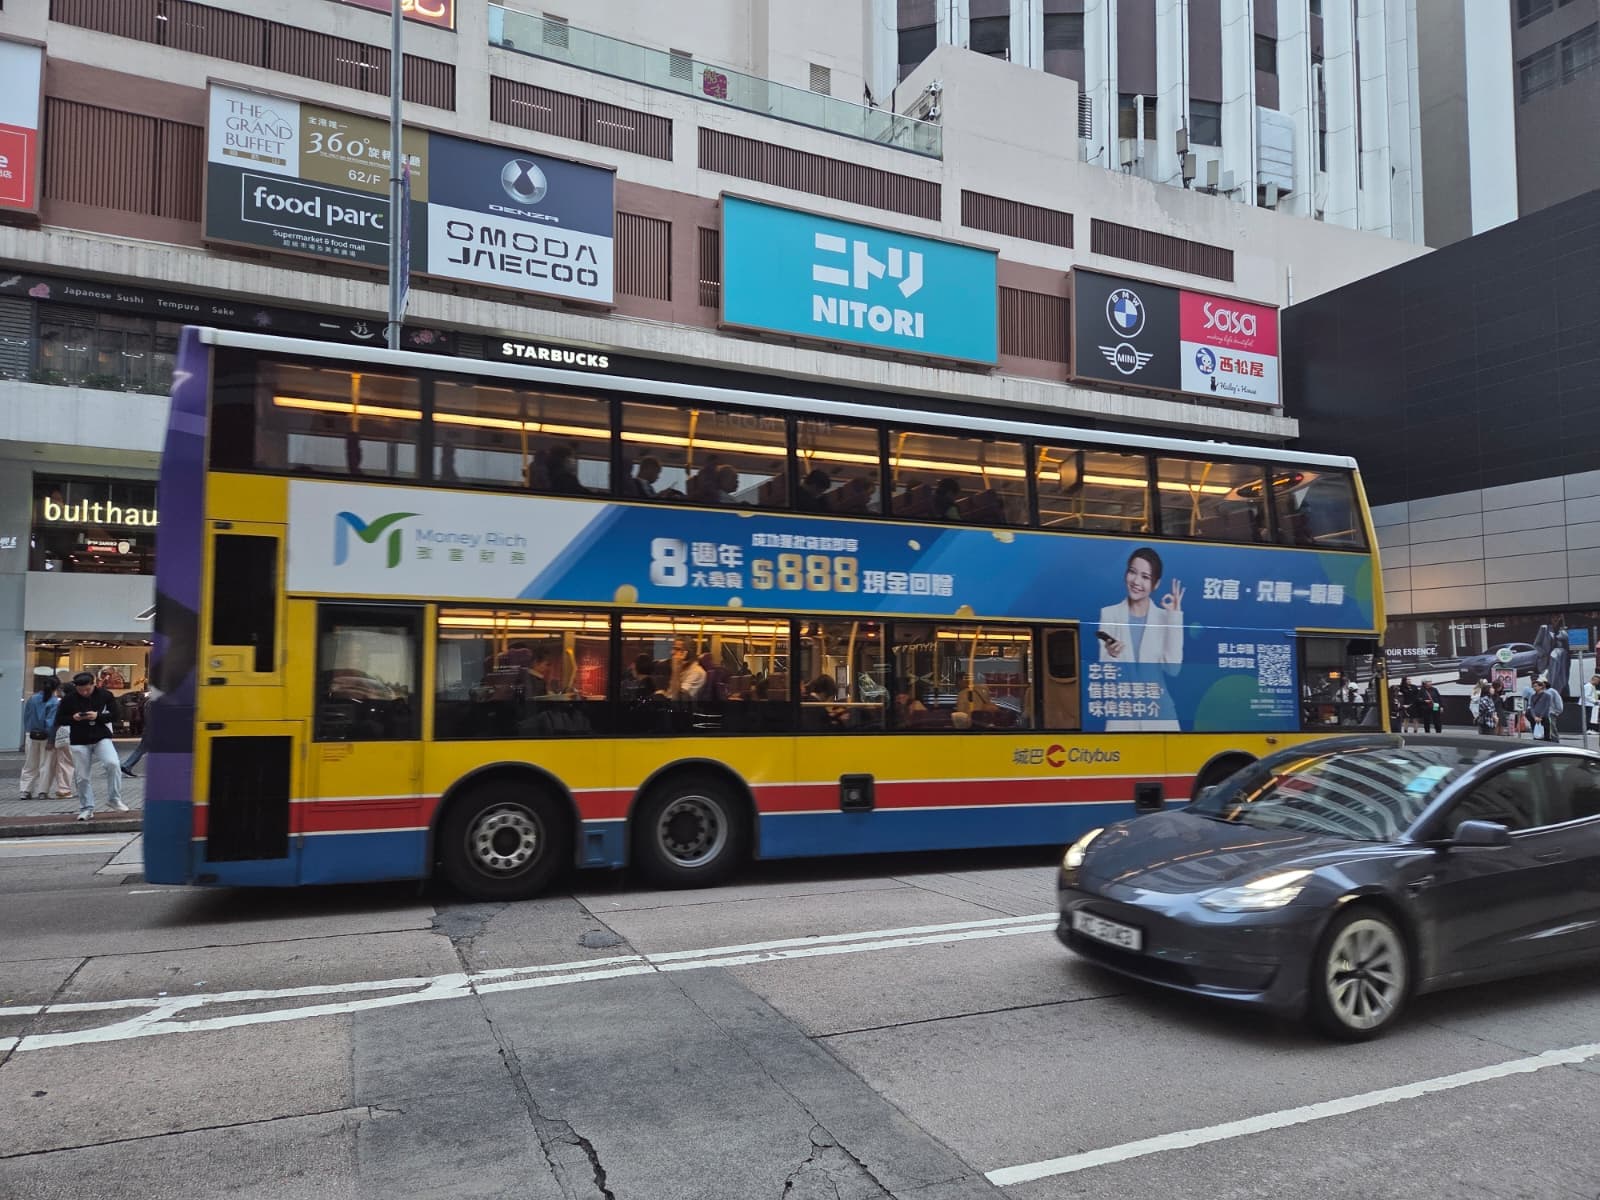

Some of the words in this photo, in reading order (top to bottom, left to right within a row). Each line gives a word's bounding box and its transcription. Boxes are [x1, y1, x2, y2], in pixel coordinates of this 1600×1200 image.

[225, 99, 262, 118] THE
[226, 117, 293, 140] GRAND
[225, 132, 285, 154] BUFFET
[348, 169, 381, 184] 62/F
[253, 186, 321, 218] food
[326, 204, 384, 230] parc
[488, 204, 559, 222] DENZA
[273, 229, 323, 245] Supermarket
[331, 239, 348, 249] food
[349, 241, 365, 251] mall
[447, 220, 598, 265] OMODA
[448, 247, 598, 287] JAECOO
[813, 232, 923, 298] ニトリ
[64, 286, 112, 300] Japanese
[116, 292, 144, 304] Sushi
[157, 299, 200, 312] Tempura
[212, 306, 234, 316] Sake
[1112, 290, 1141, 307] BMW
[813, 294, 924, 339] NITORI
[502, 342, 609, 368] STARBUCKS
[1116, 352, 1136, 365] MINI
[1220, 356, 1264, 377] 西松屋
[415, 528, 481, 548] Money
[485, 531, 528, 548] Rich
[650, 537, 688, 587] 8
[691, 542, 744, 568] 週年
[1448, 622, 1505, 630] PORSCHE
[1068, 747, 1120, 764] Citybus
